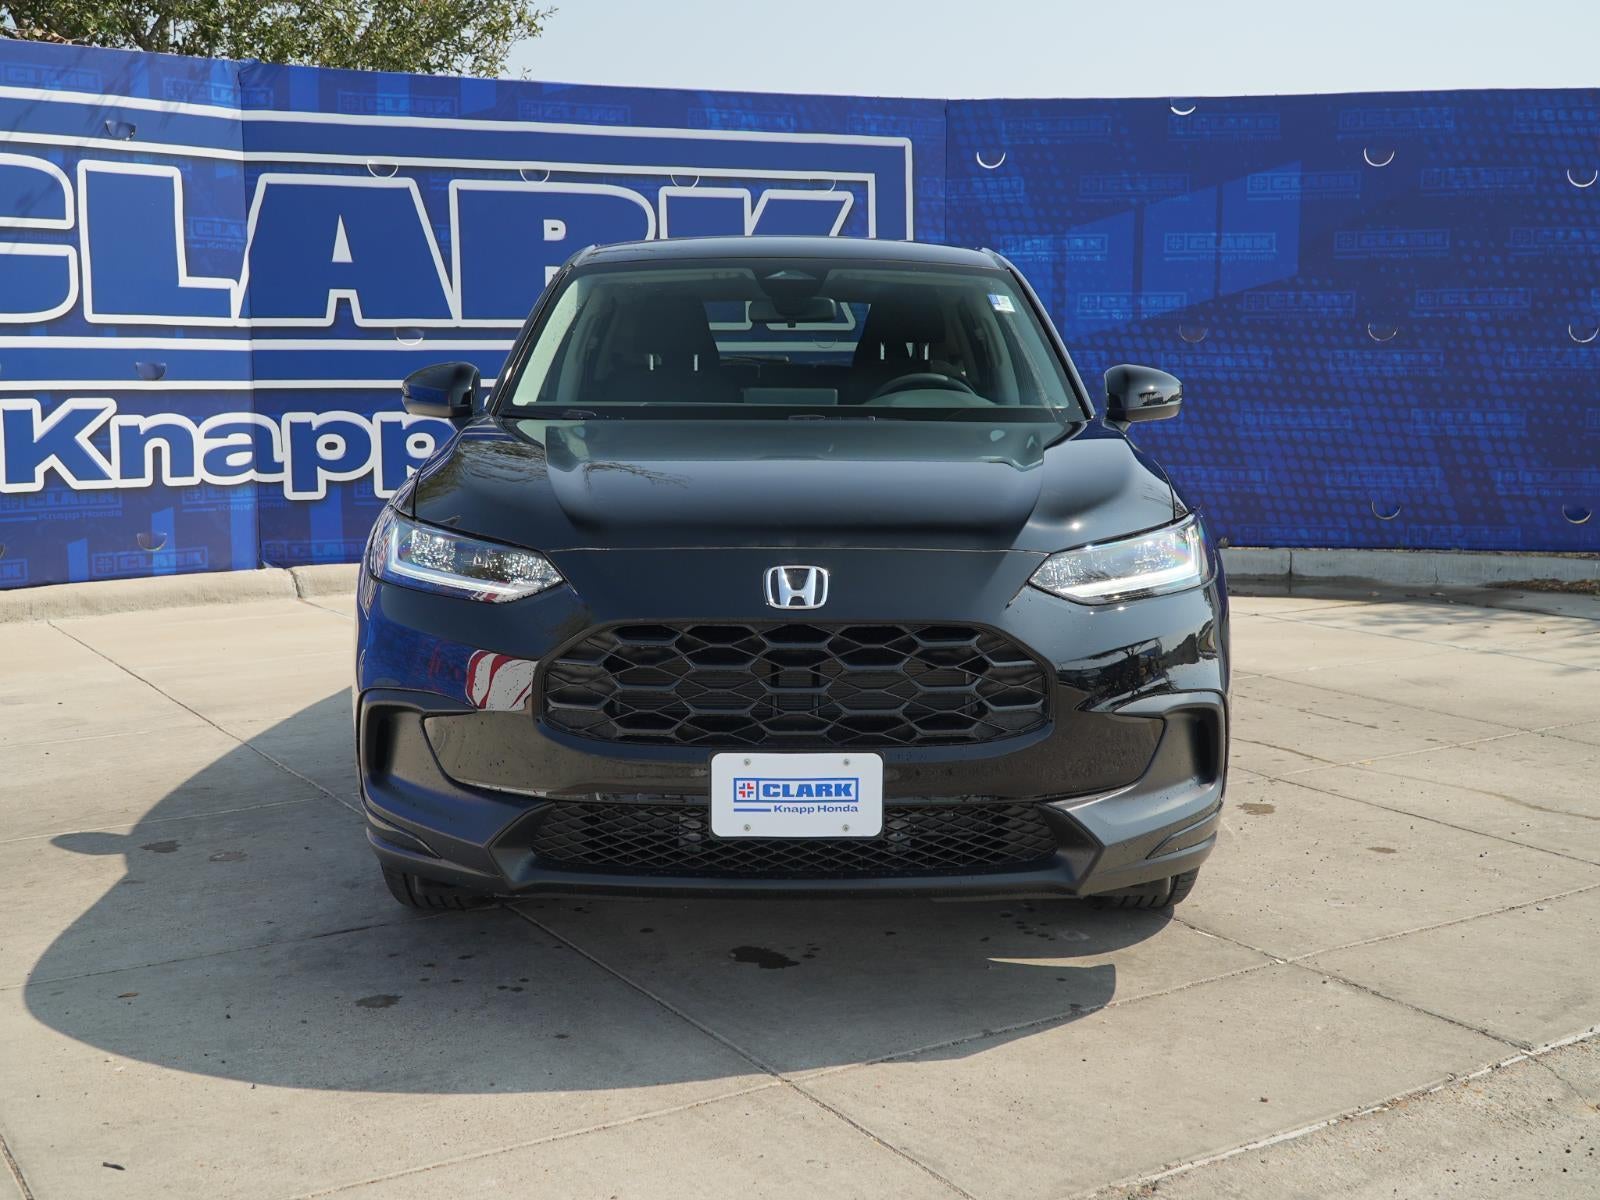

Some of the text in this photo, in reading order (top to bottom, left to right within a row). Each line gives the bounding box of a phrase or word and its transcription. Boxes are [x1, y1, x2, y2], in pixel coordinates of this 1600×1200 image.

[1189, 236, 1272, 249] CLARK
[0, 397, 456, 501] Knapp
[762, 783, 853, 798] CLARK
[773, 805, 858, 815] Knapp Honda
